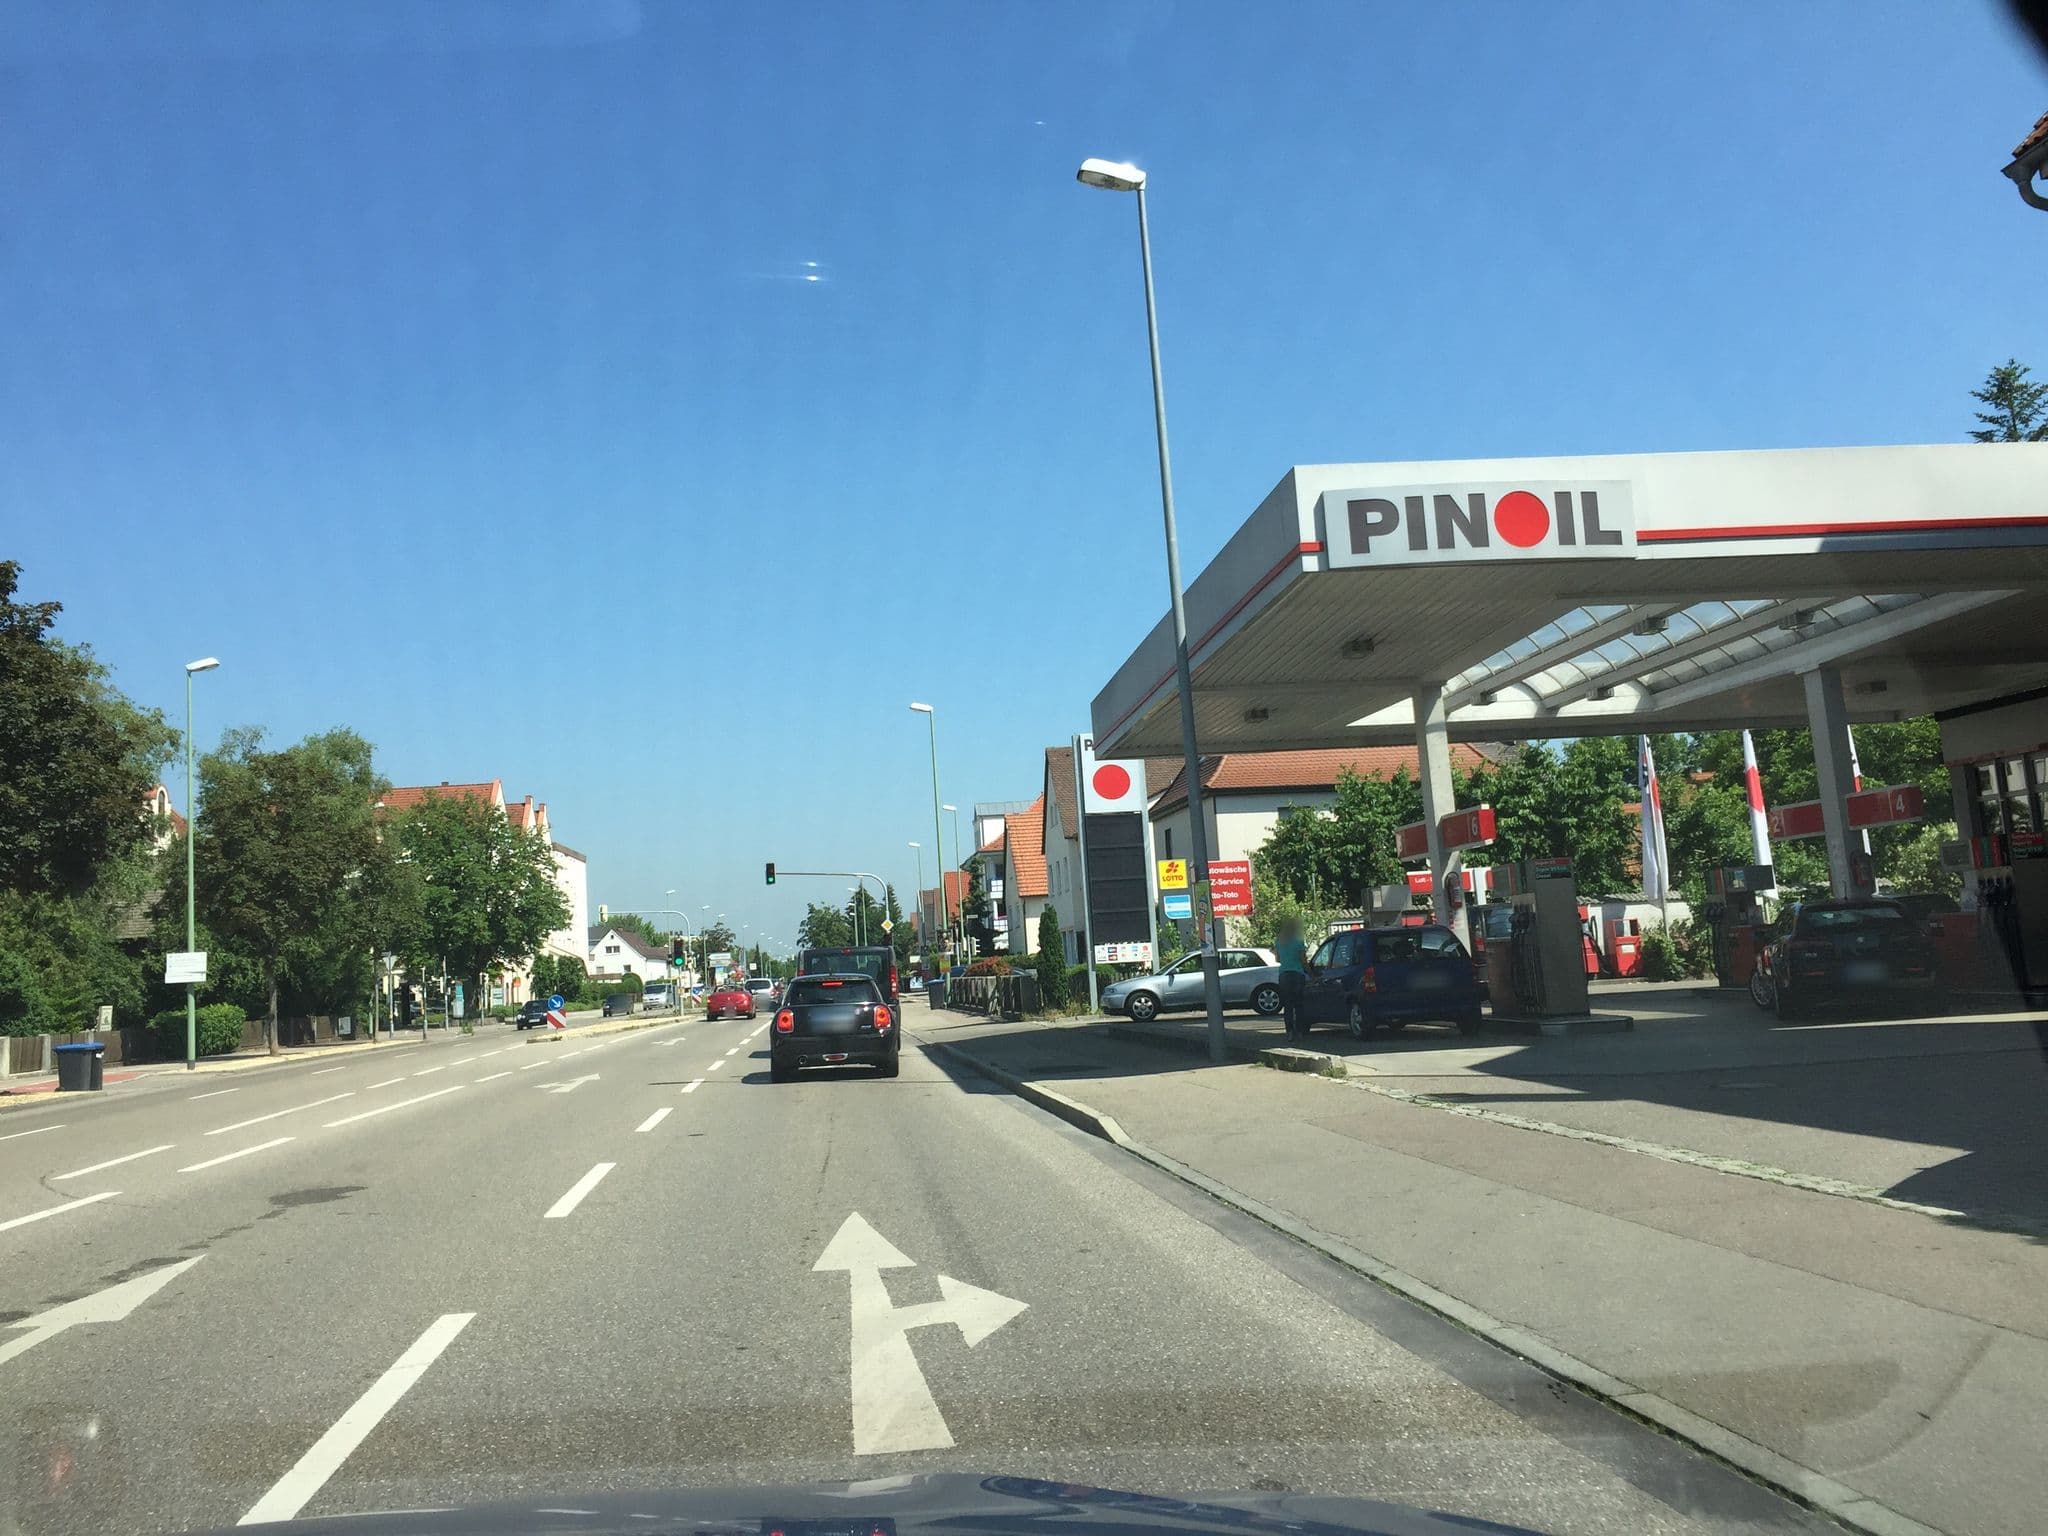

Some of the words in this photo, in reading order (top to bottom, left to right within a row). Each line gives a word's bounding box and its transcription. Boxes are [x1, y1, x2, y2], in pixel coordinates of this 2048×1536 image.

[1347, 490, 1622, 554] PINOIL
[1895, 794, 1904, 812] 4
[1471, 815, 1478, 836] 6
